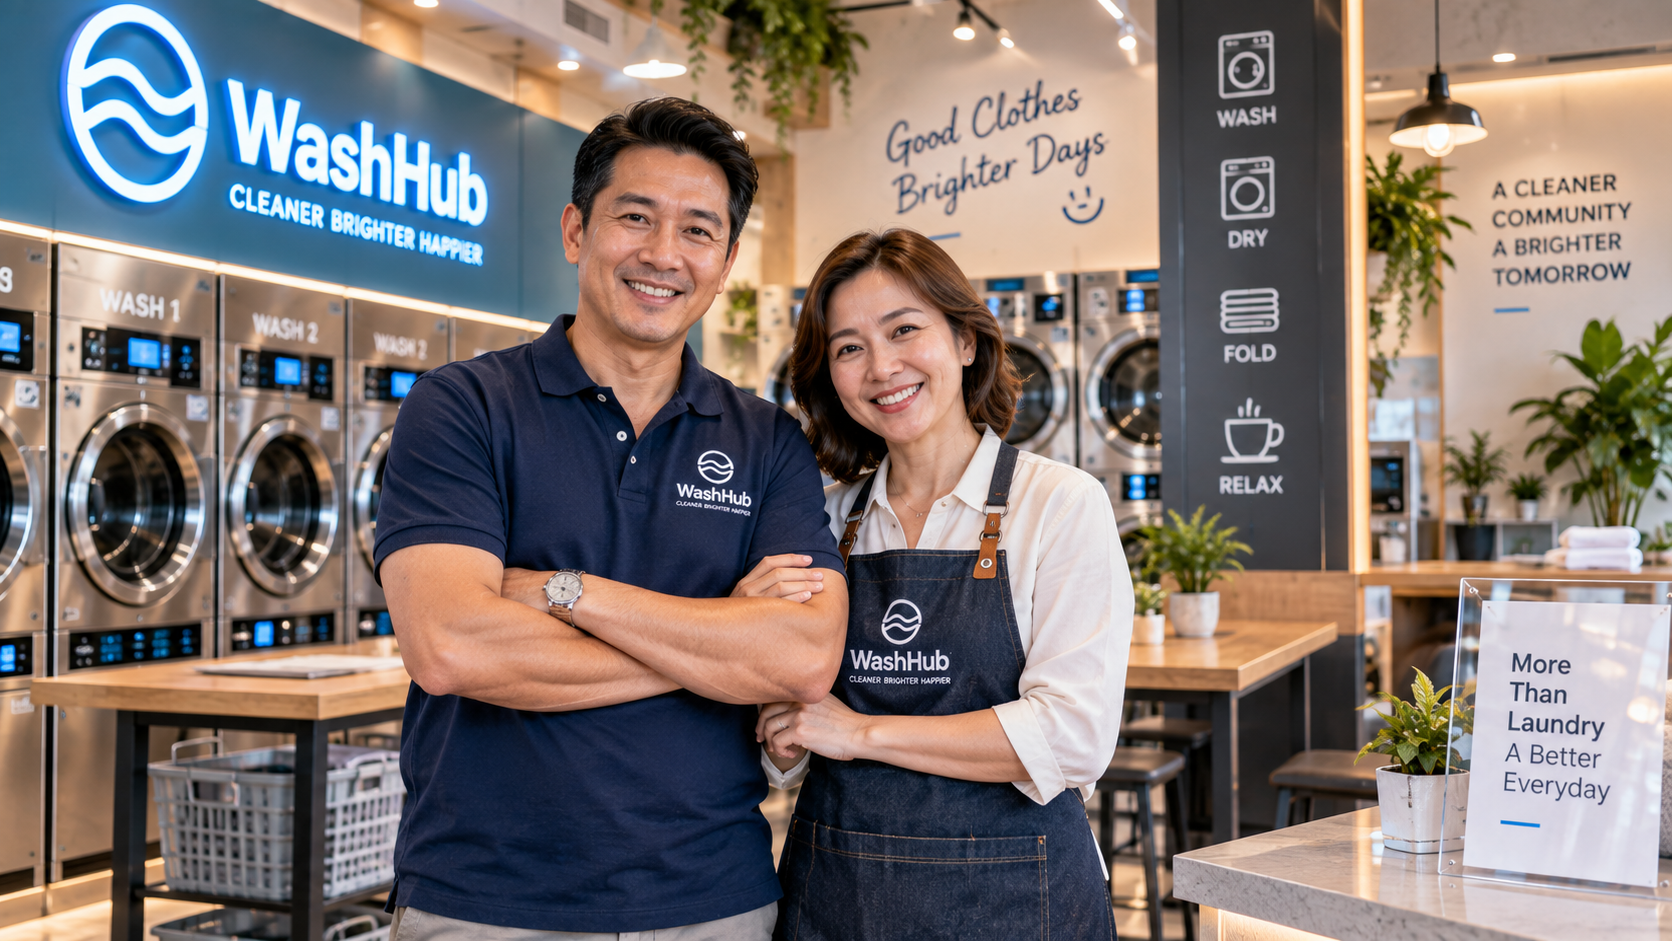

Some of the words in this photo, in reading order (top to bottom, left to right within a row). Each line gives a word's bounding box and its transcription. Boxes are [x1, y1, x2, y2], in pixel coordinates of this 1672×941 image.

[886, 105, 962, 168] Good
[971, 79, 1082, 139] Clothes
[1217, 106, 1277, 127] WASH
[226, 77, 489, 227] WashHub
[891, 153, 1018, 216] Brighter
[1026, 131, 1110, 178] Days
[1492, 181, 1507, 200] A
[1514, 174, 1617, 198] CLEANER
[229, 182, 325, 230] CLEANER
[330, 207, 416, 251] BRIGHTER
[418, 229, 484, 267] HAPPIER
[1492, 202, 1632, 229] COMMUNITY
[1228, 229, 1269, 249] DRY
[1492, 238, 1507, 258] A
[1514, 232, 1622, 257] BRIGHTER
[1492, 260, 1632, 287] TOMORROW
[101, 288, 165, 320] WASH
[170, 298, 181, 323] 1
[252, 311, 304, 341] WASH
[307, 321, 319, 344] 2
[373, 331, 416, 358] WASH
[1223, 344, 1277, 363] FOLD
[676, 483, 752, 507] WashHub
[1219, 475, 1284, 495] RELAX
[850, 649, 950, 672] WashHub
[1511, 652, 1572, 675] More
[849, 676, 881, 684] CLEANER
[883, 676, 919, 685] BRIGHTER
[1509, 681, 1568, 705] Than
[1507, 710, 1606, 742] Laundry
[1504, 742, 1522, 764] A
[1529, 743, 1602, 769] Better
[1503, 771, 1611, 806] Everyday
